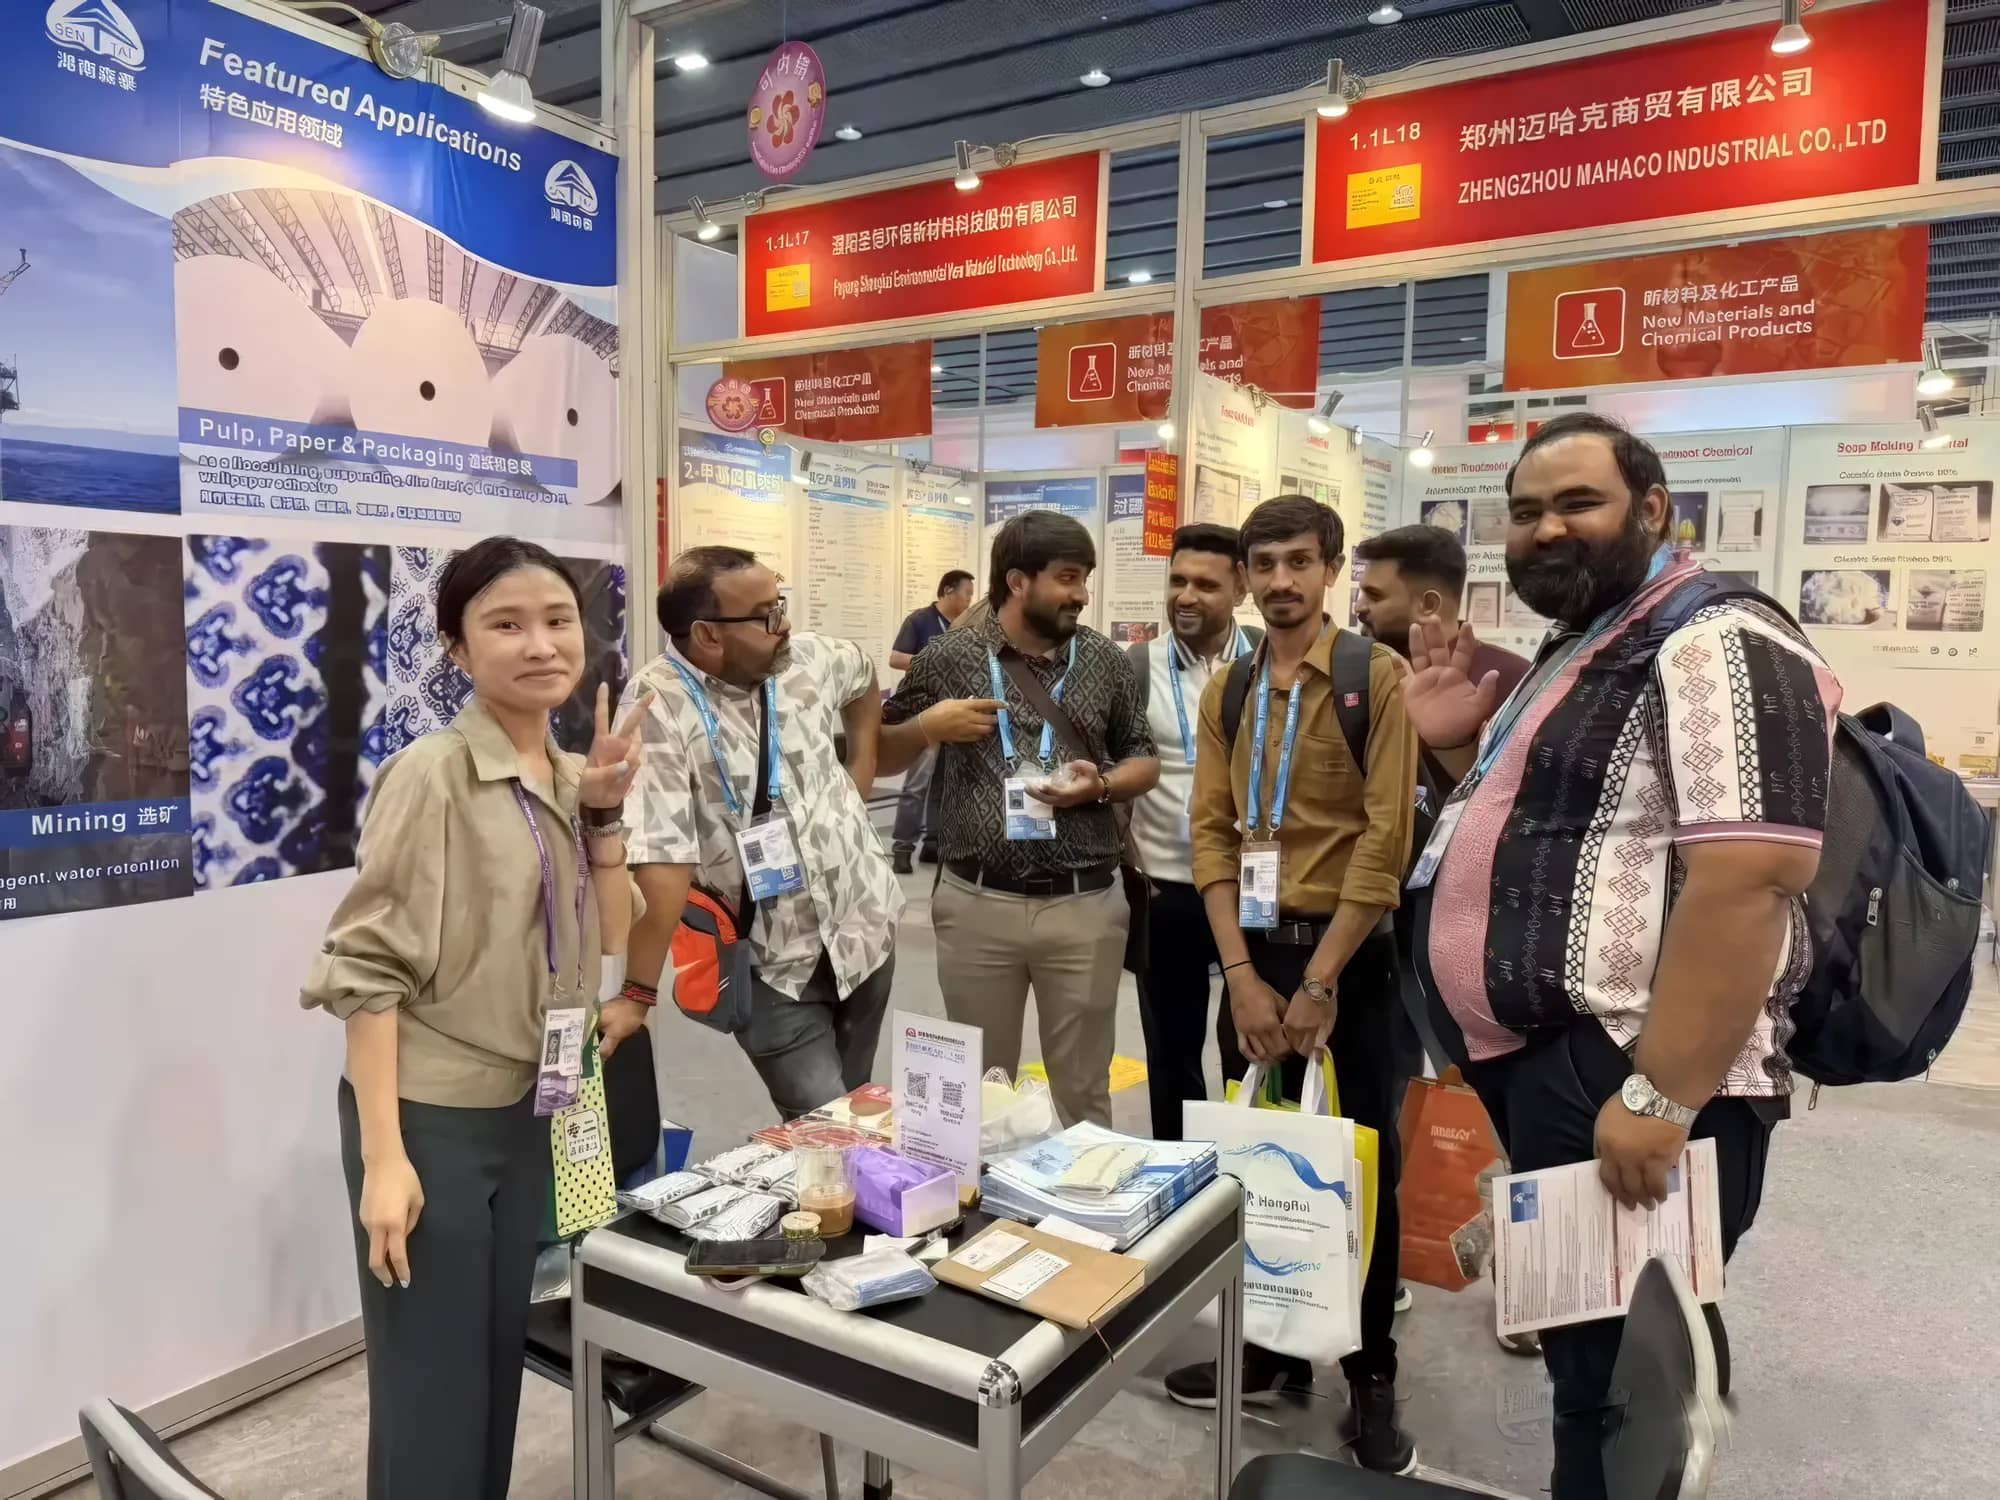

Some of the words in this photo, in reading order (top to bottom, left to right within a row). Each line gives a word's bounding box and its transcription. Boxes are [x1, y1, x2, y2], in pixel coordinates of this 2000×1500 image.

[54, 22, 85, 43] SEN
[200, 37, 349, 112] Featured
[356, 95, 522, 172] Applications
[200, 83, 343, 149] 特色应用领域
[1459, 66, 1814, 153] 郑州迈哈克商贸有限公司
[1349, 122, 1422, 151] 1.1L18
[1458, 168, 1571, 204] ZHENGZHOU
[1576, 151, 1662, 187] MAHACO
[1666, 134, 1793, 174] INDUSTRIAL
[1799, 117, 1887, 154] CO.,LTD
[766, 230, 809, 252] 1.1L17
[1643, 274, 1799, 307] 新材料及化工产品
[1688, 304, 1773, 325] Materials
[1779, 299, 1815, 316] and
[1728, 320, 1813, 344] Products
[199, 417, 263, 448] Pulp,
[269, 426, 336, 453] Paper
[342, 435, 357, 454] &
[362, 438, 464, 472] Packaging
[31, 811, 127, 836] Mining
[137, 805, 179, 826] 选矿
